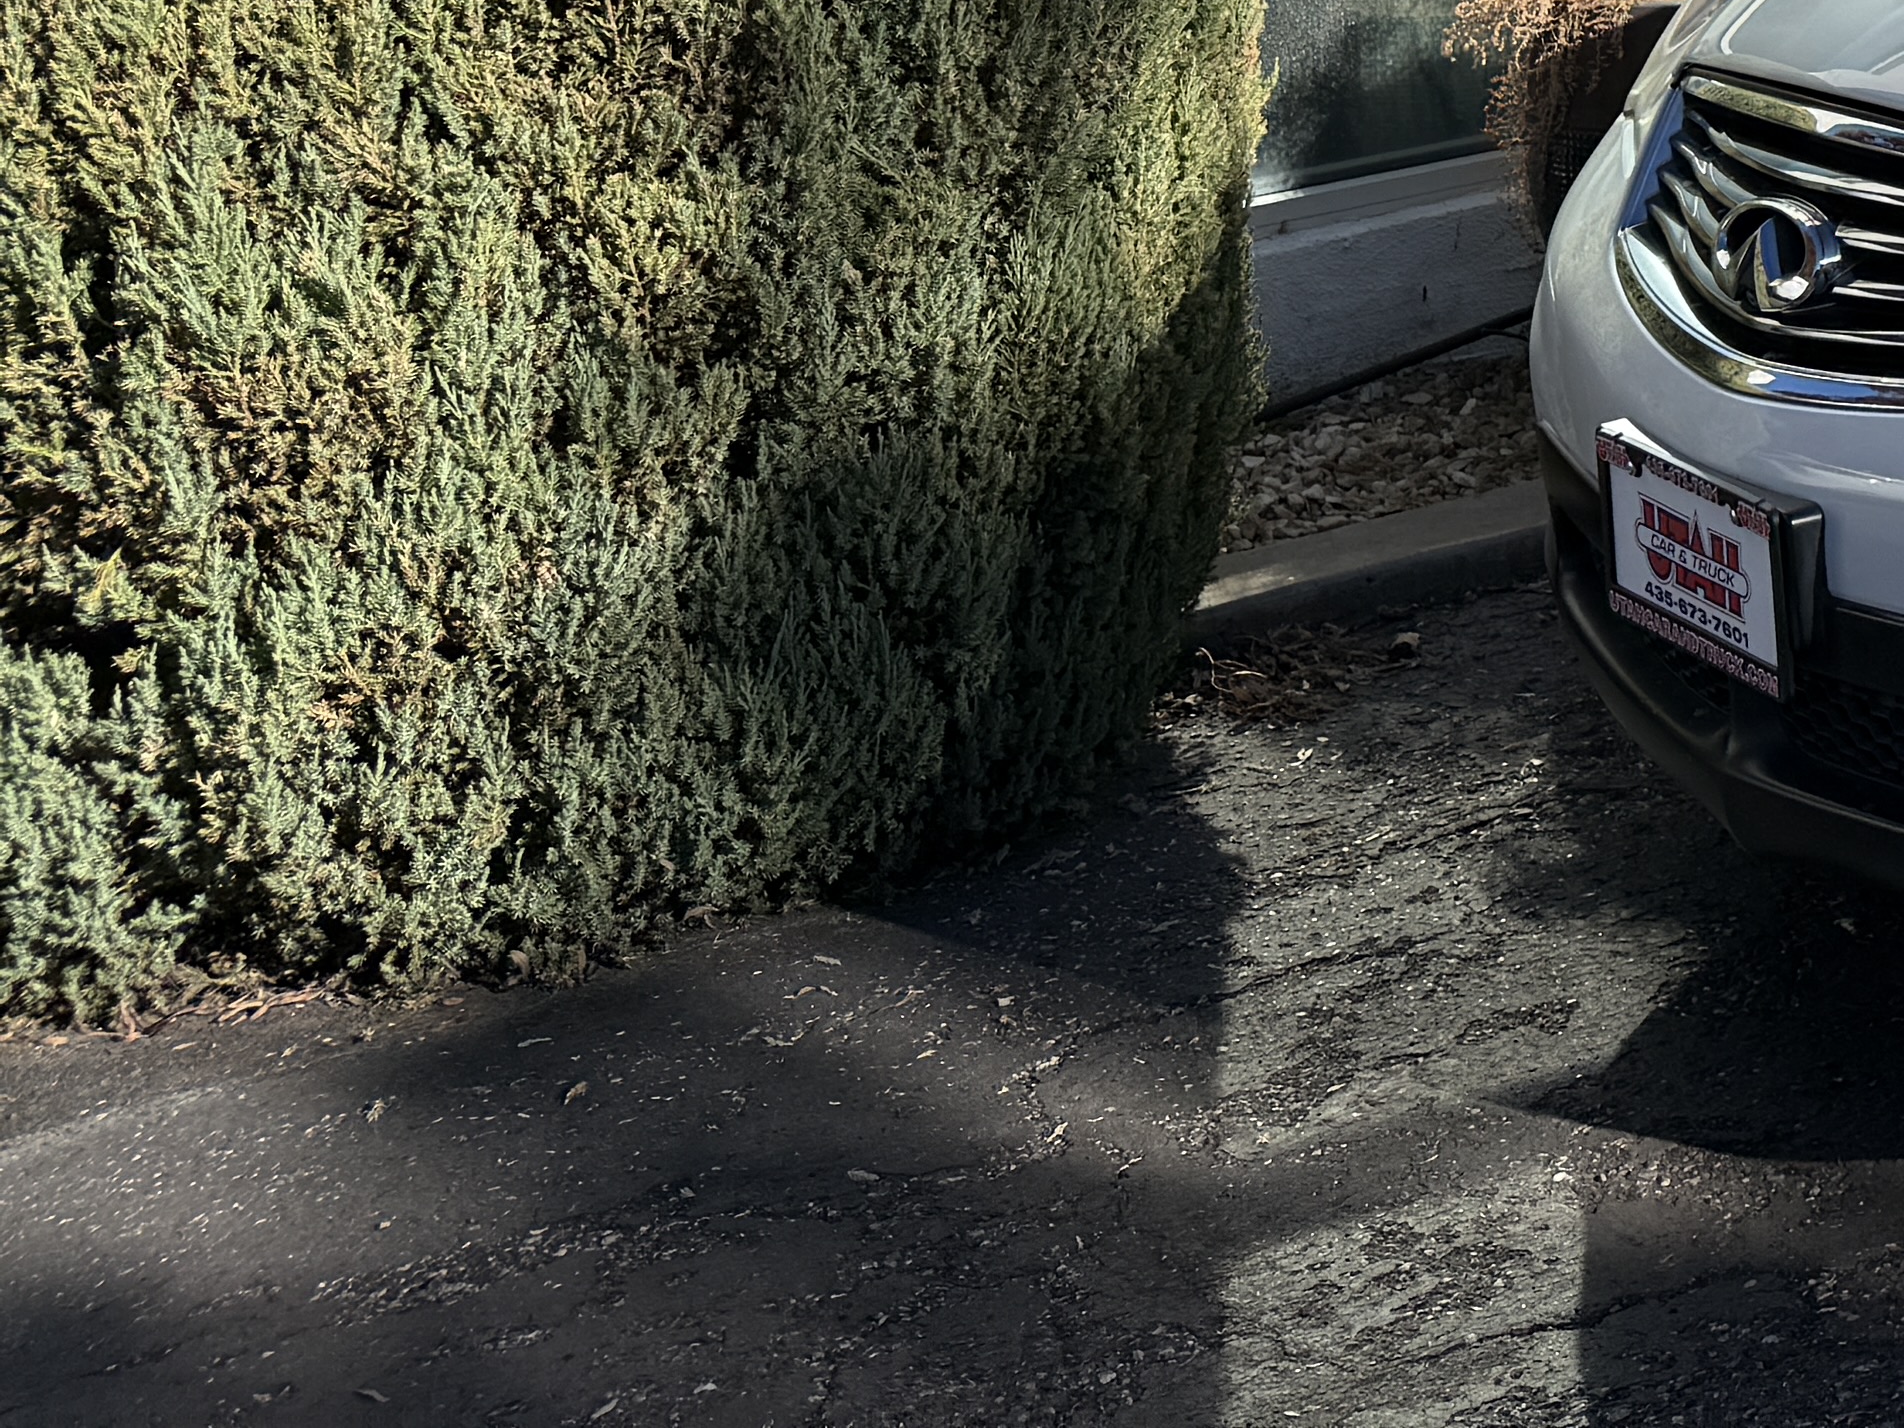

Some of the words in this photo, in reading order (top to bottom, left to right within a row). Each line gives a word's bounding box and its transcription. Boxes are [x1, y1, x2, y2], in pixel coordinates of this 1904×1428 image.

[1650, 534, 1676, 558] CAR
[1678, 549, 1687, 564] &
[1692, 554, 1735, 587] TRUCK
